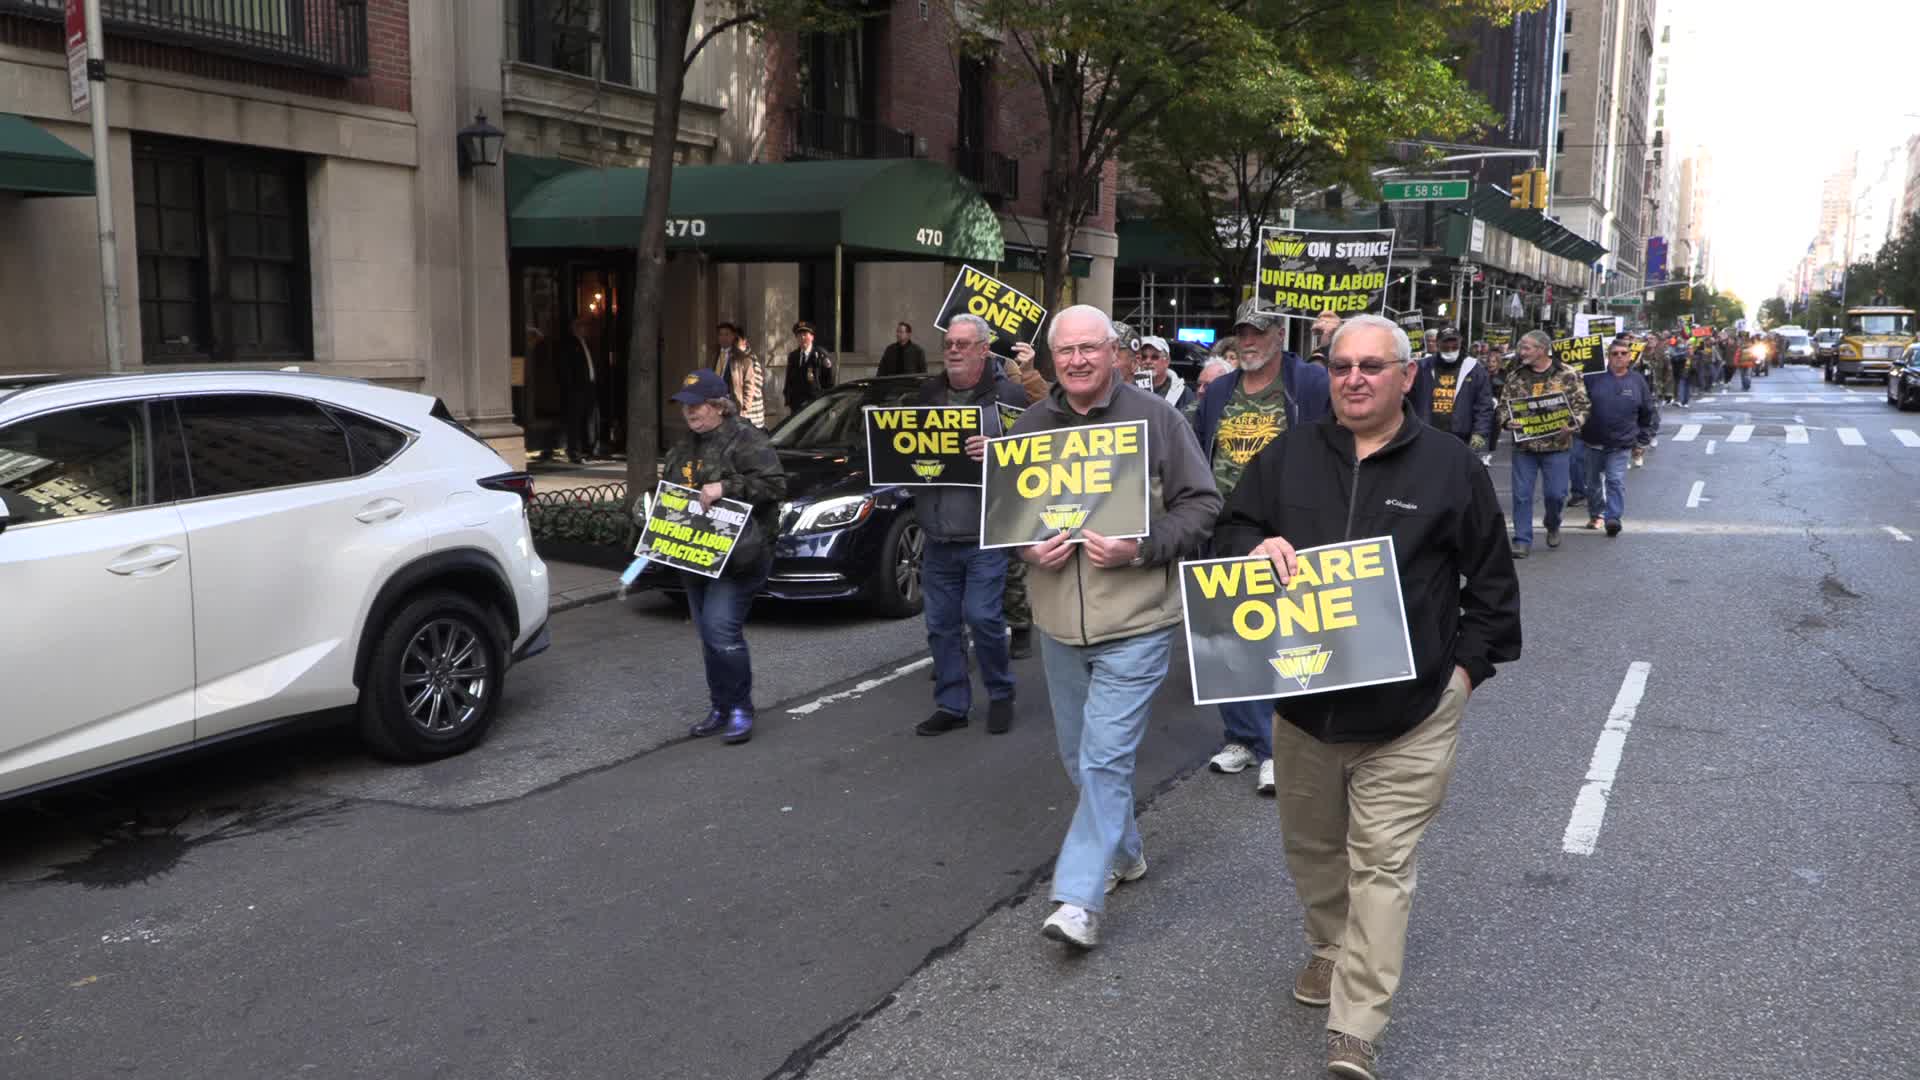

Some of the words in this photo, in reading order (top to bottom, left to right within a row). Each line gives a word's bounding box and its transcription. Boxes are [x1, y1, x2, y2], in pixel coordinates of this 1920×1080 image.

[1404, 186, 1411, 197] E
[1415, 184, 1428, 197] 58
[1432, 185, 1443, 196] St
[916, 228, 943, 246] 470
[1307, 241, 1331, 257] ON
[1335, 241, 1390, 258] STRIKE
[1261, 268, 1325, 290] UNFAIR
[1329, 272, 1385, 291] LABOR
[964, 269, 1001, 299] WE
[999, 291, 1041, 324] ARE
[1275, 291, 1369, 312] PRACTICES
[968, 295, 1023, 335] ONE
[1552, 341, 1571, 351] WE
[1573, 335, 1600, 349] ARE
[1561, 347, 1592, 362] ONE
[873, 410, 918, 430] WE
[923, 409, 977, 430] ARE
[893, 431, 960, 455] ONE
[994, 435, 1052, 467] WE
[1060, 426, 1138, 459] ARE
[1016, 460, 1112, 499] ONE
[705, 505, 746, 526] STRIKE
[648, 516, 693, 542] UNFAIR
[693, 530, 733, 553] LABOR
[651, 537, 715, 567] PRACTICES
[1192, 559, 1275, 599] WE
[1287, 544, 1384, 591] ARE
[1232, 586, 1357, 641] ONE
